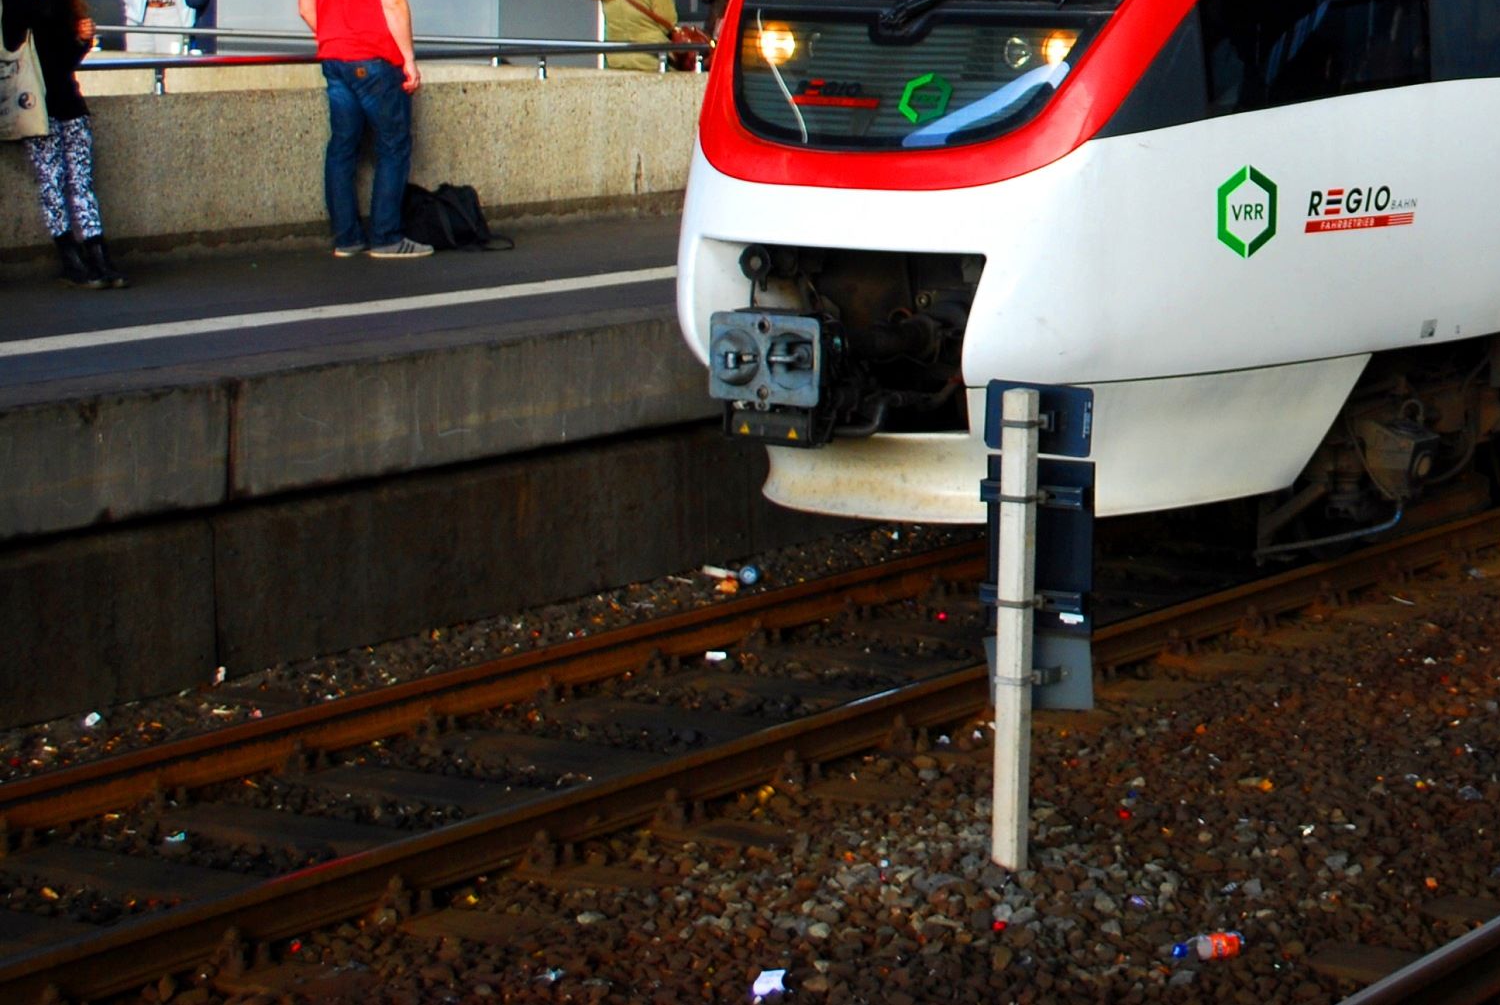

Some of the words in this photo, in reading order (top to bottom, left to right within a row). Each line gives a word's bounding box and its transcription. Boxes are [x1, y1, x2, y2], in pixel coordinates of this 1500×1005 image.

[1307, 185, 1391, 217] REGIO
[1231, 203, 1264, 221] VRR
[1319, 217, 1375, 230] FAHRBETRIEB
